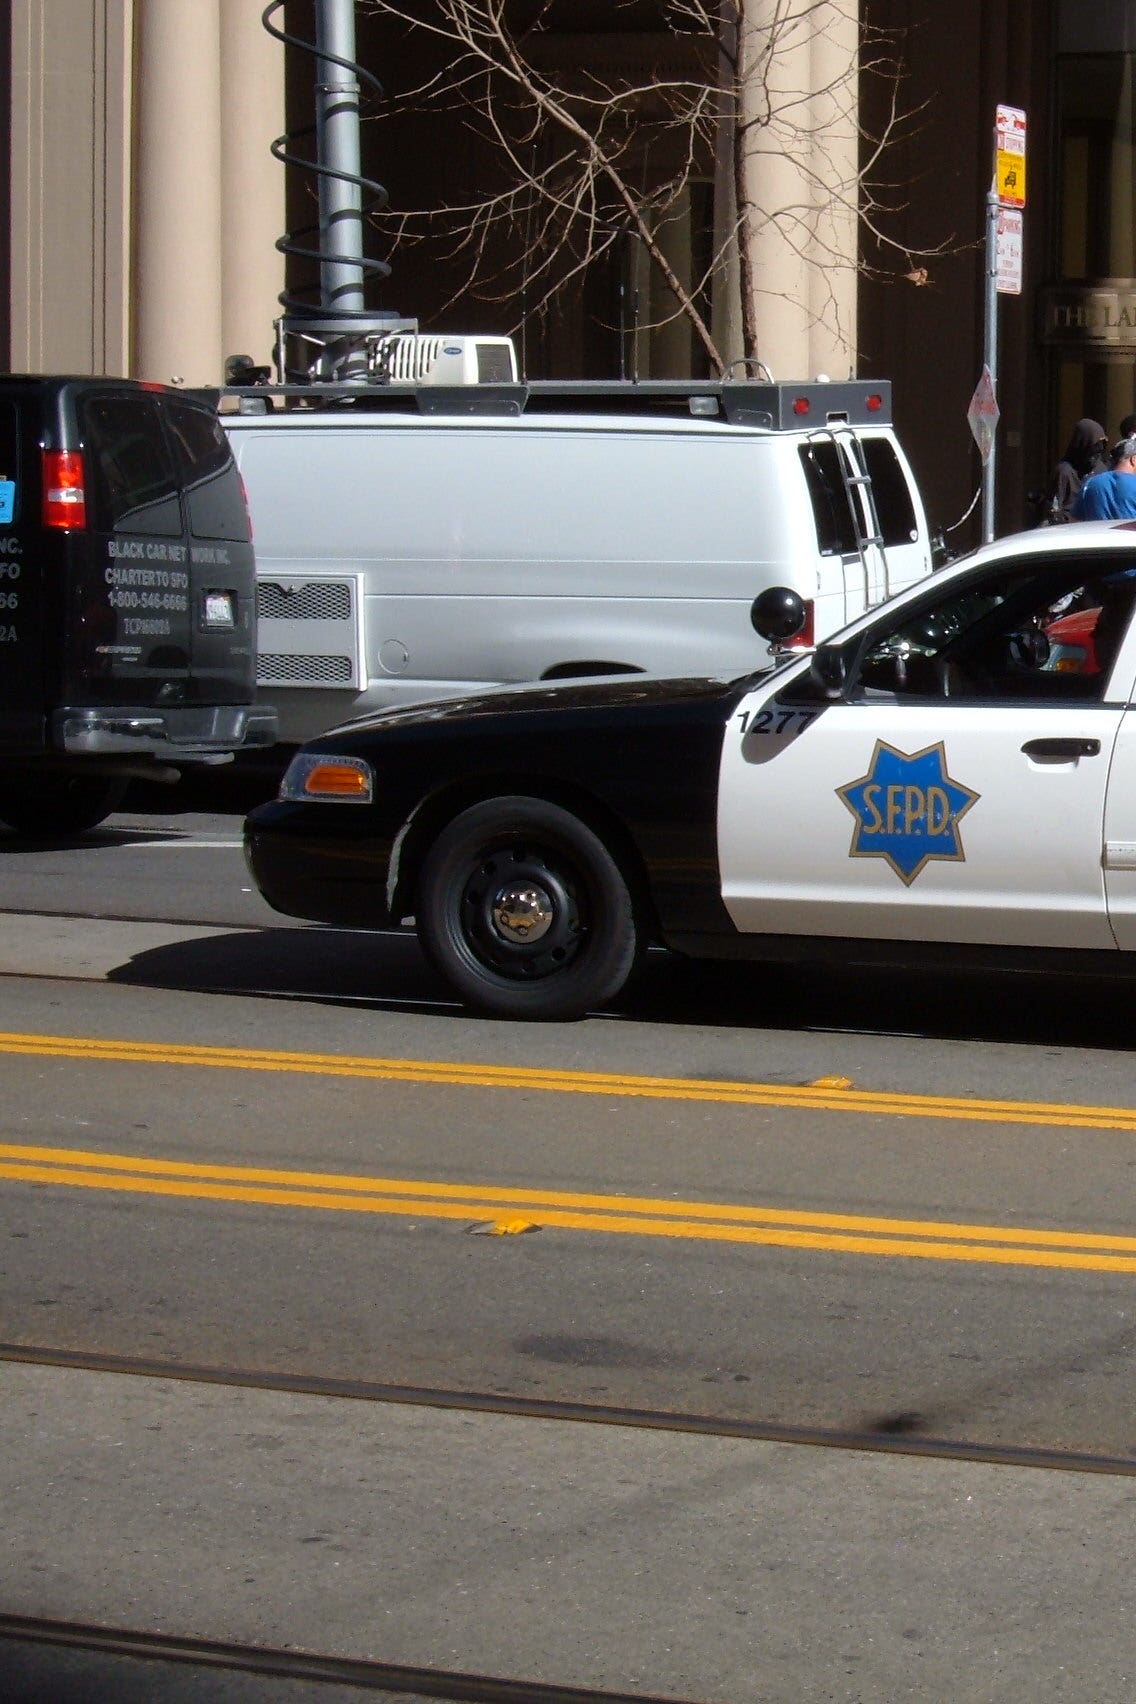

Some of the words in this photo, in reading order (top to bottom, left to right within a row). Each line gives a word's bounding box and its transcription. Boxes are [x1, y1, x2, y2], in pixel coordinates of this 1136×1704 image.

[108, 540, 144, 560] BLACK
[146, 543, 167, 561] CAR
[105, 567, 155, 588] CHARTER
[156, 570, 169, 588] TO
[736, 710, 817, 734] 1277
